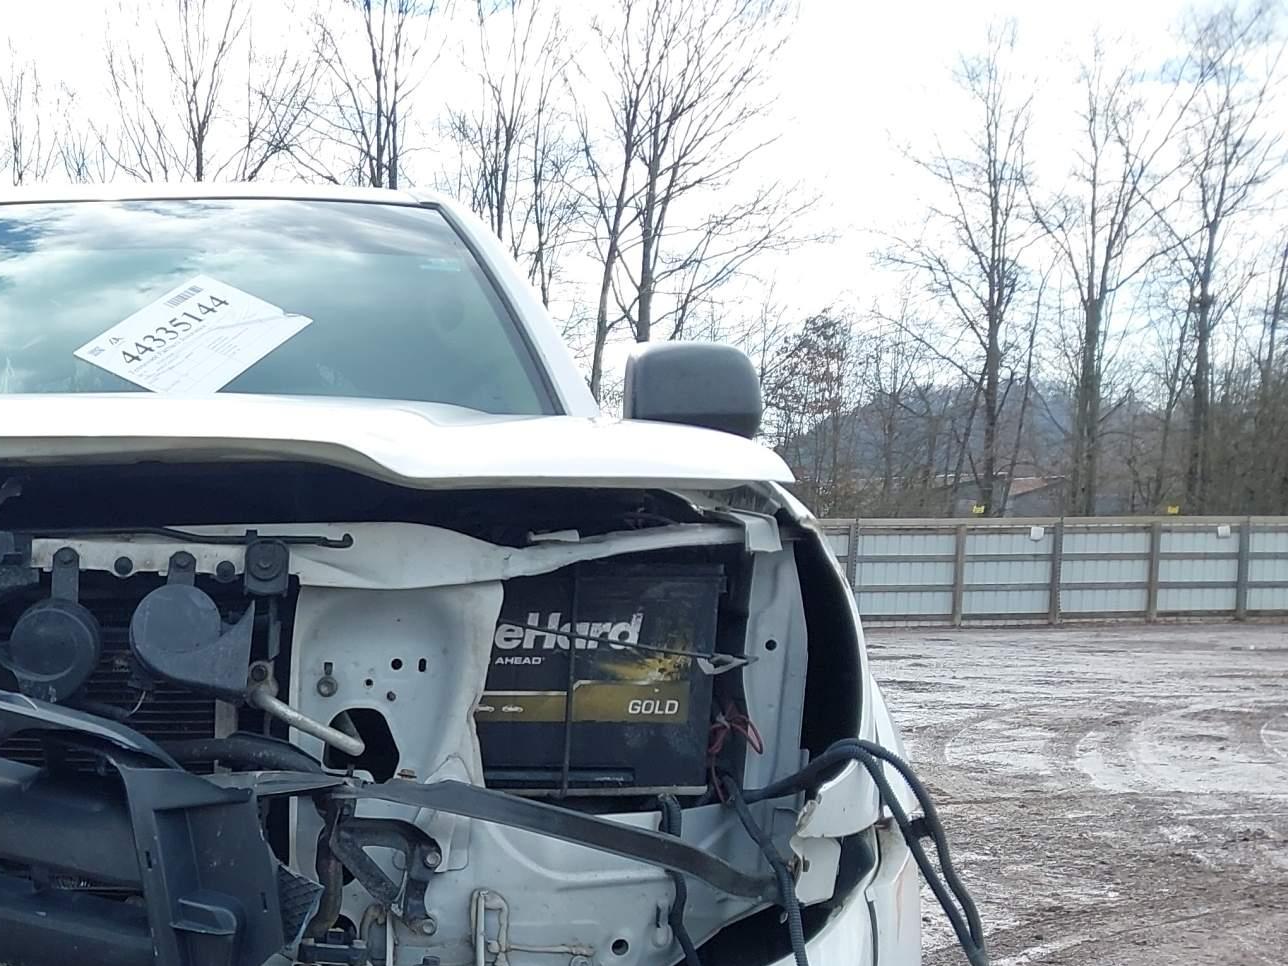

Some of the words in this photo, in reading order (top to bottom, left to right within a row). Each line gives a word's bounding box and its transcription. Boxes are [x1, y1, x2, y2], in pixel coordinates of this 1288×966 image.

[120, 294, 230, 365] 44335144
[495, 656, 542, 665] AHEAD
[627, 699, 680, 715] GOLD
